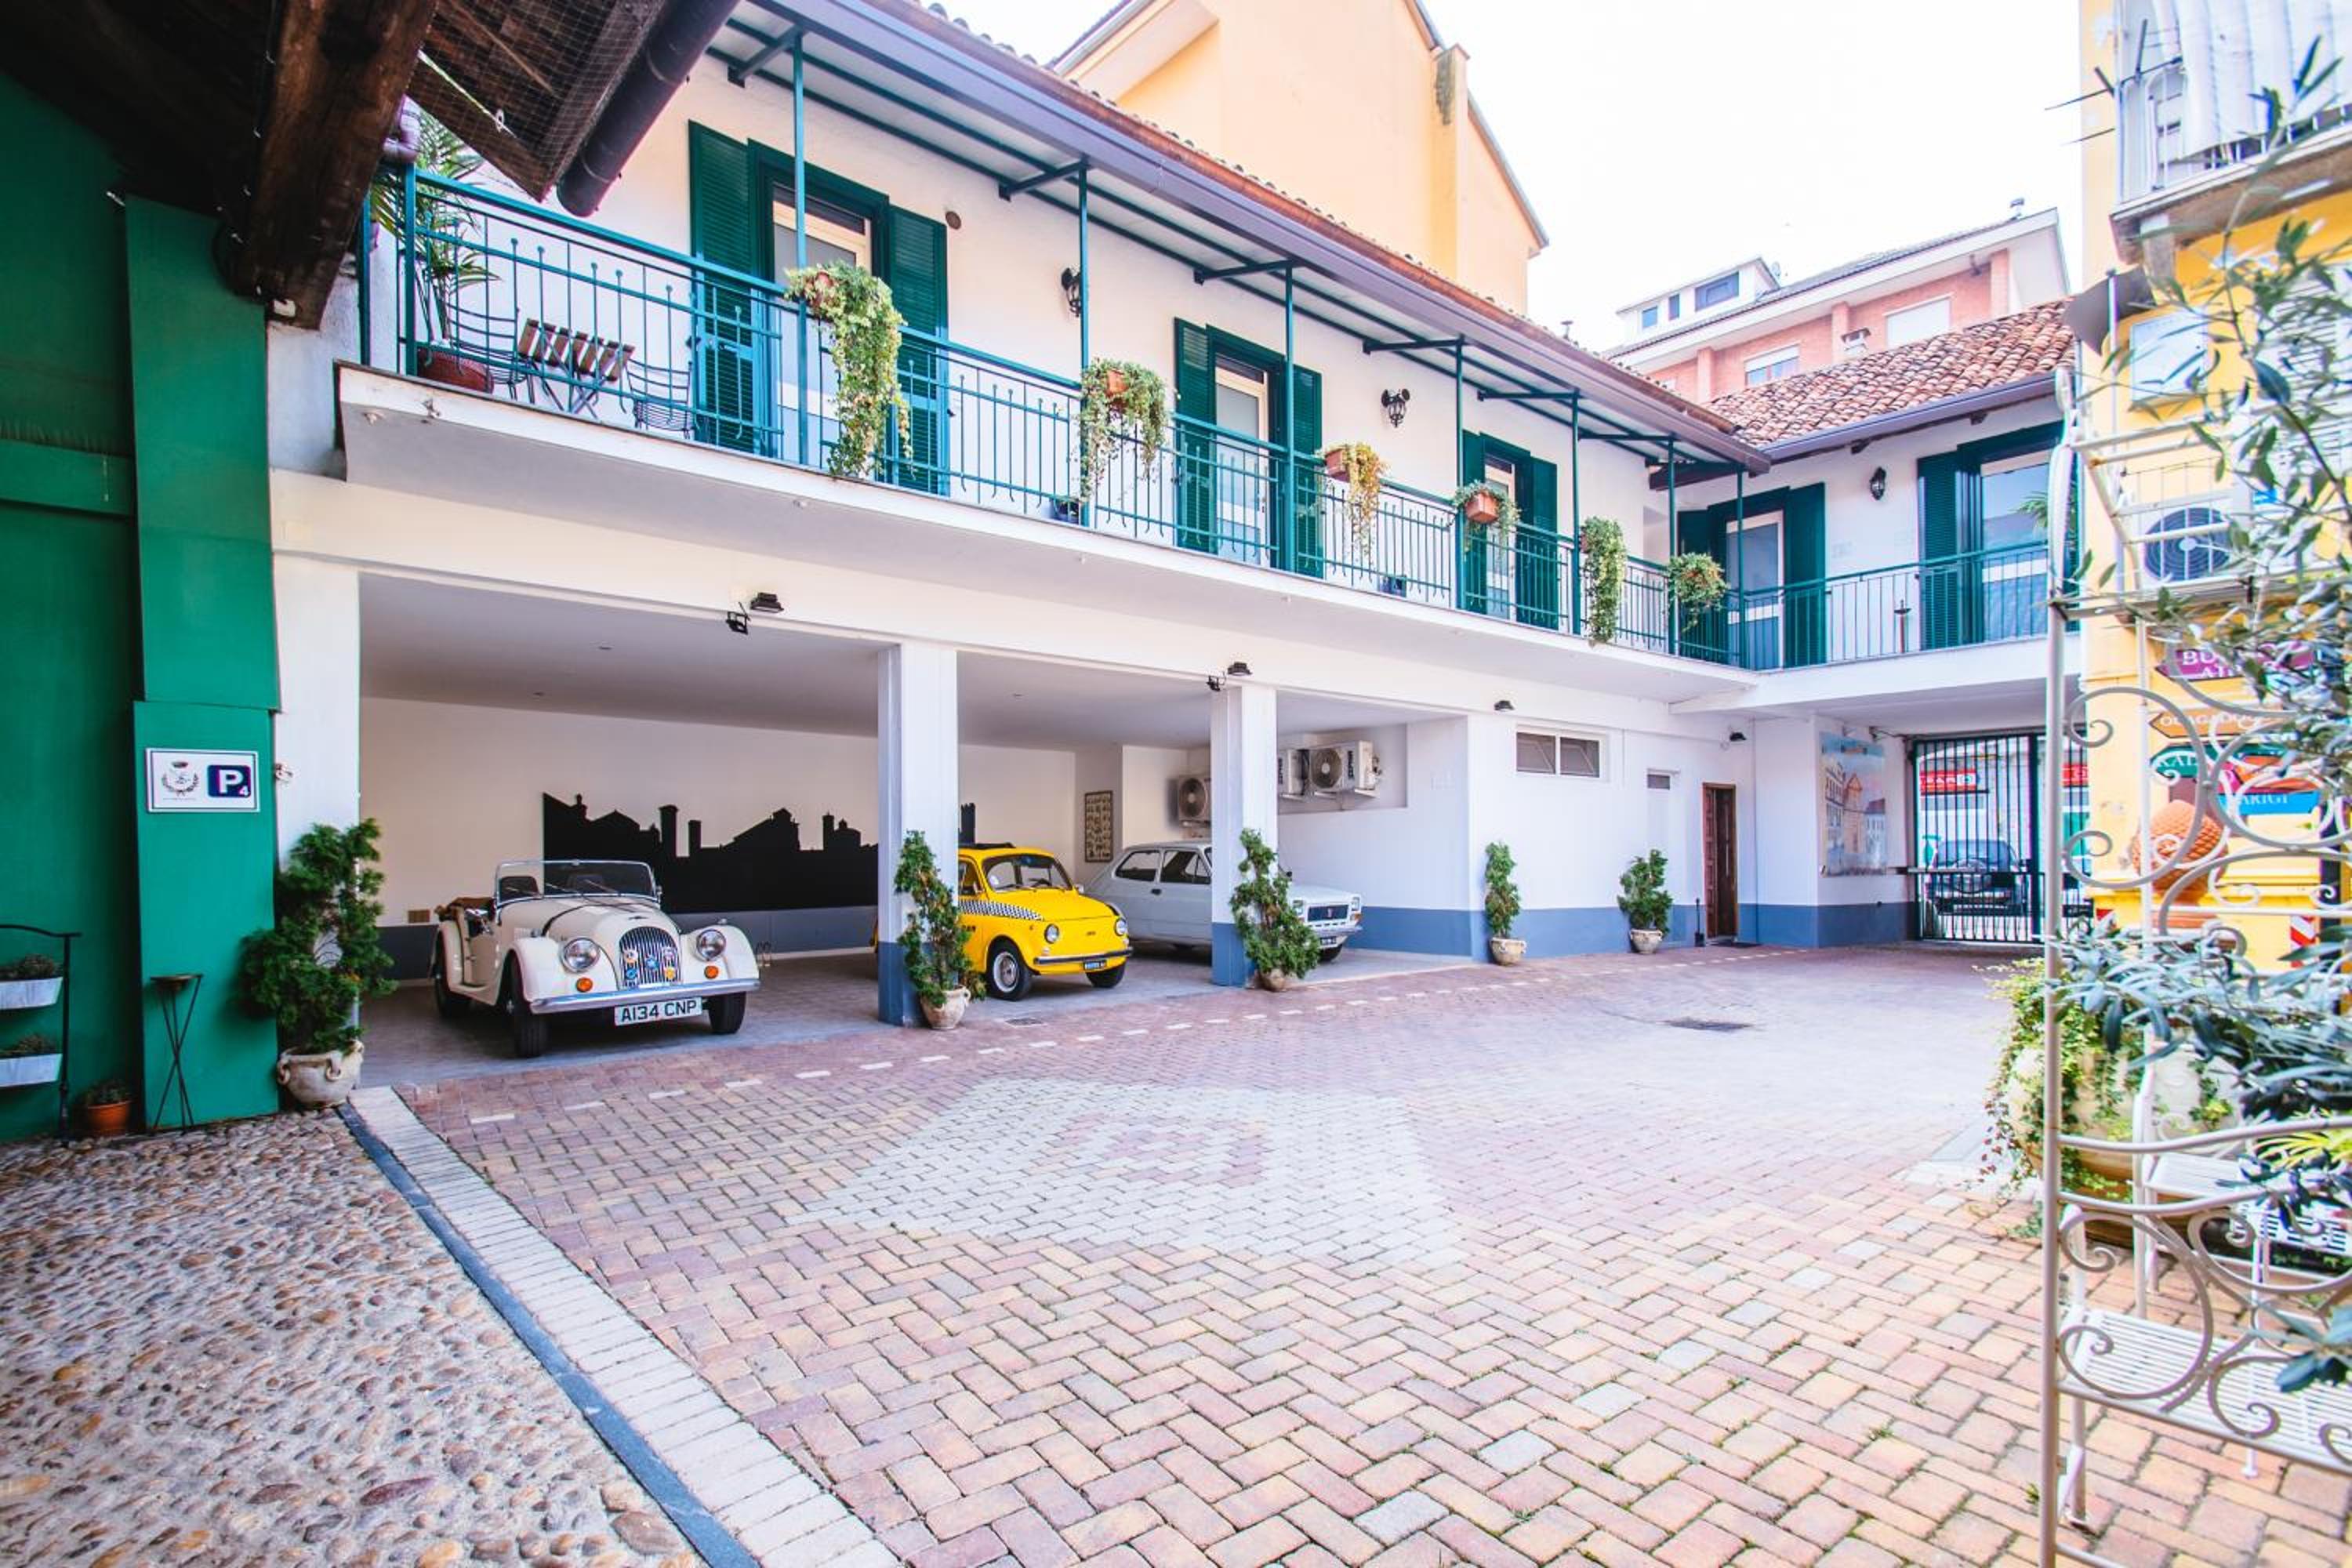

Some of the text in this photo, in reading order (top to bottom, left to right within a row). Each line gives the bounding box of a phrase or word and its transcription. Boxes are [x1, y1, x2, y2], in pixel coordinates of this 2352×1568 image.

[219, 769, 244, 794] P
[2238, 793, 2288, 805] ARIGI
[621, 999, 697, 1022] A134 CNP
